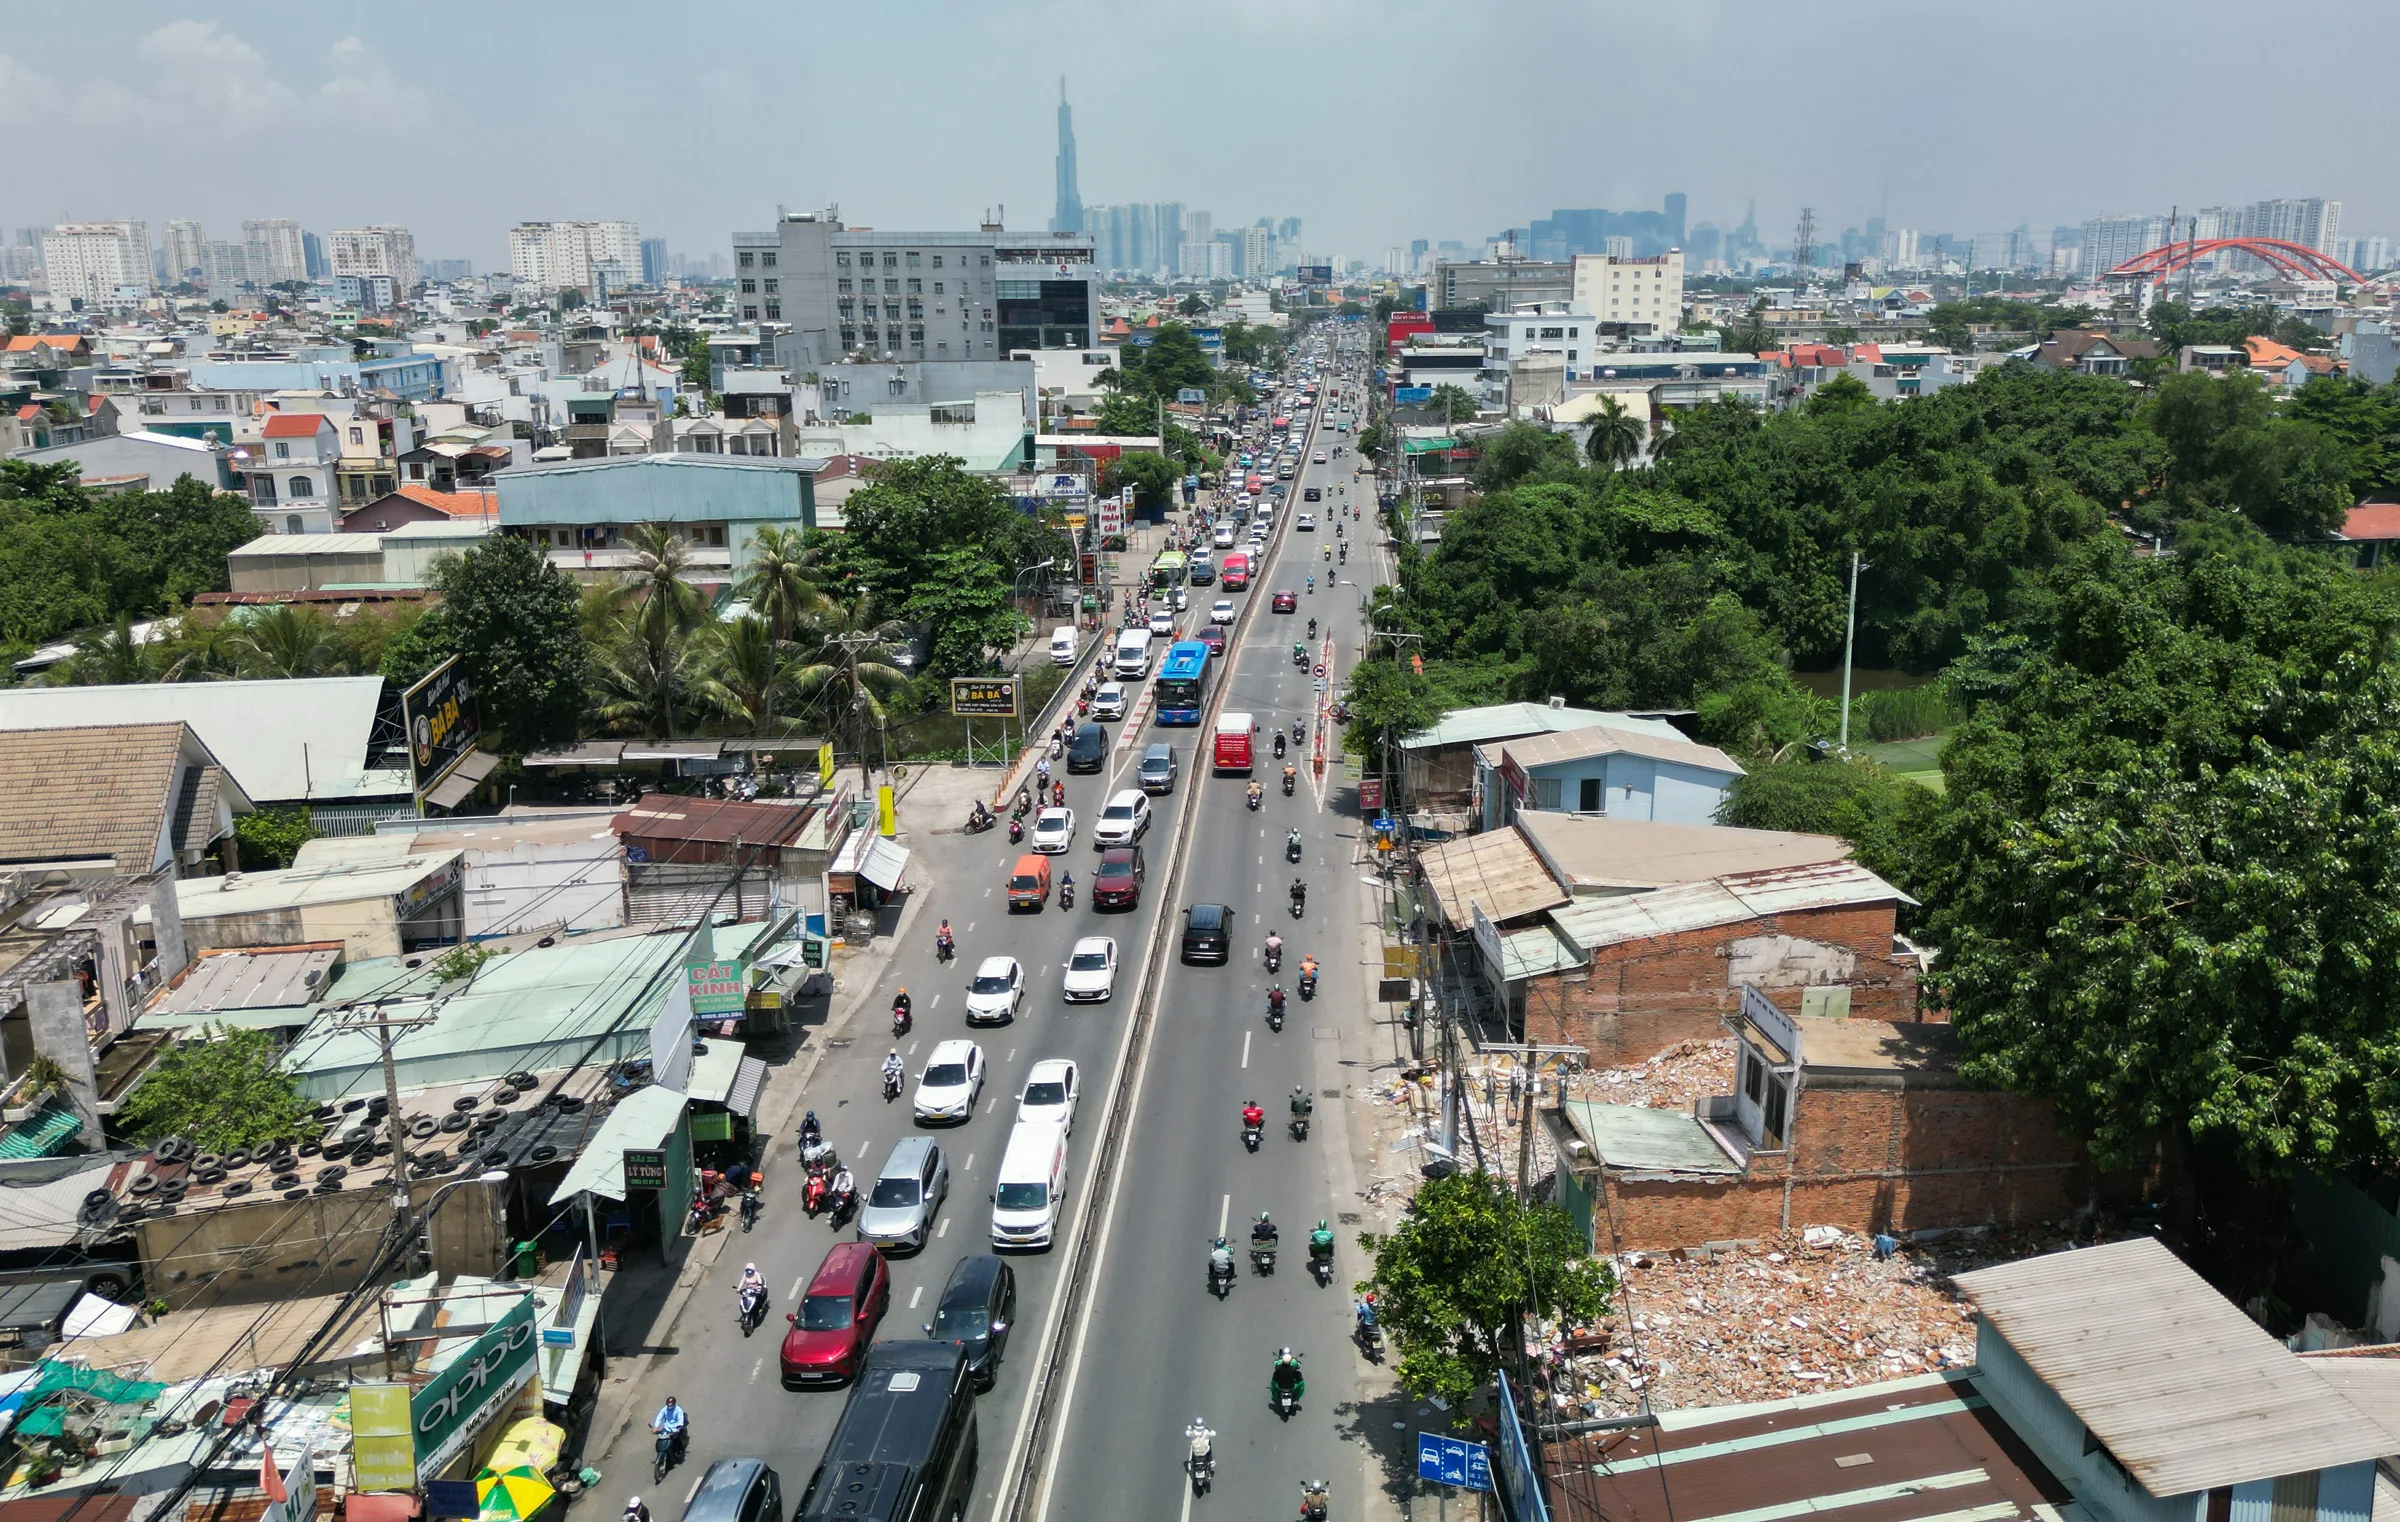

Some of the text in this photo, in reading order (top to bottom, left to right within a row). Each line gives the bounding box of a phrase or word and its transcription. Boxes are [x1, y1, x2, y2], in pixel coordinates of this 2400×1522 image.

[1136, 336, 1154, 345] Ford
[429, 703, 447, 746] BÀ
[692, 962, 734, 982] CẮT
[688, 979, 741, 997] KÍNH
